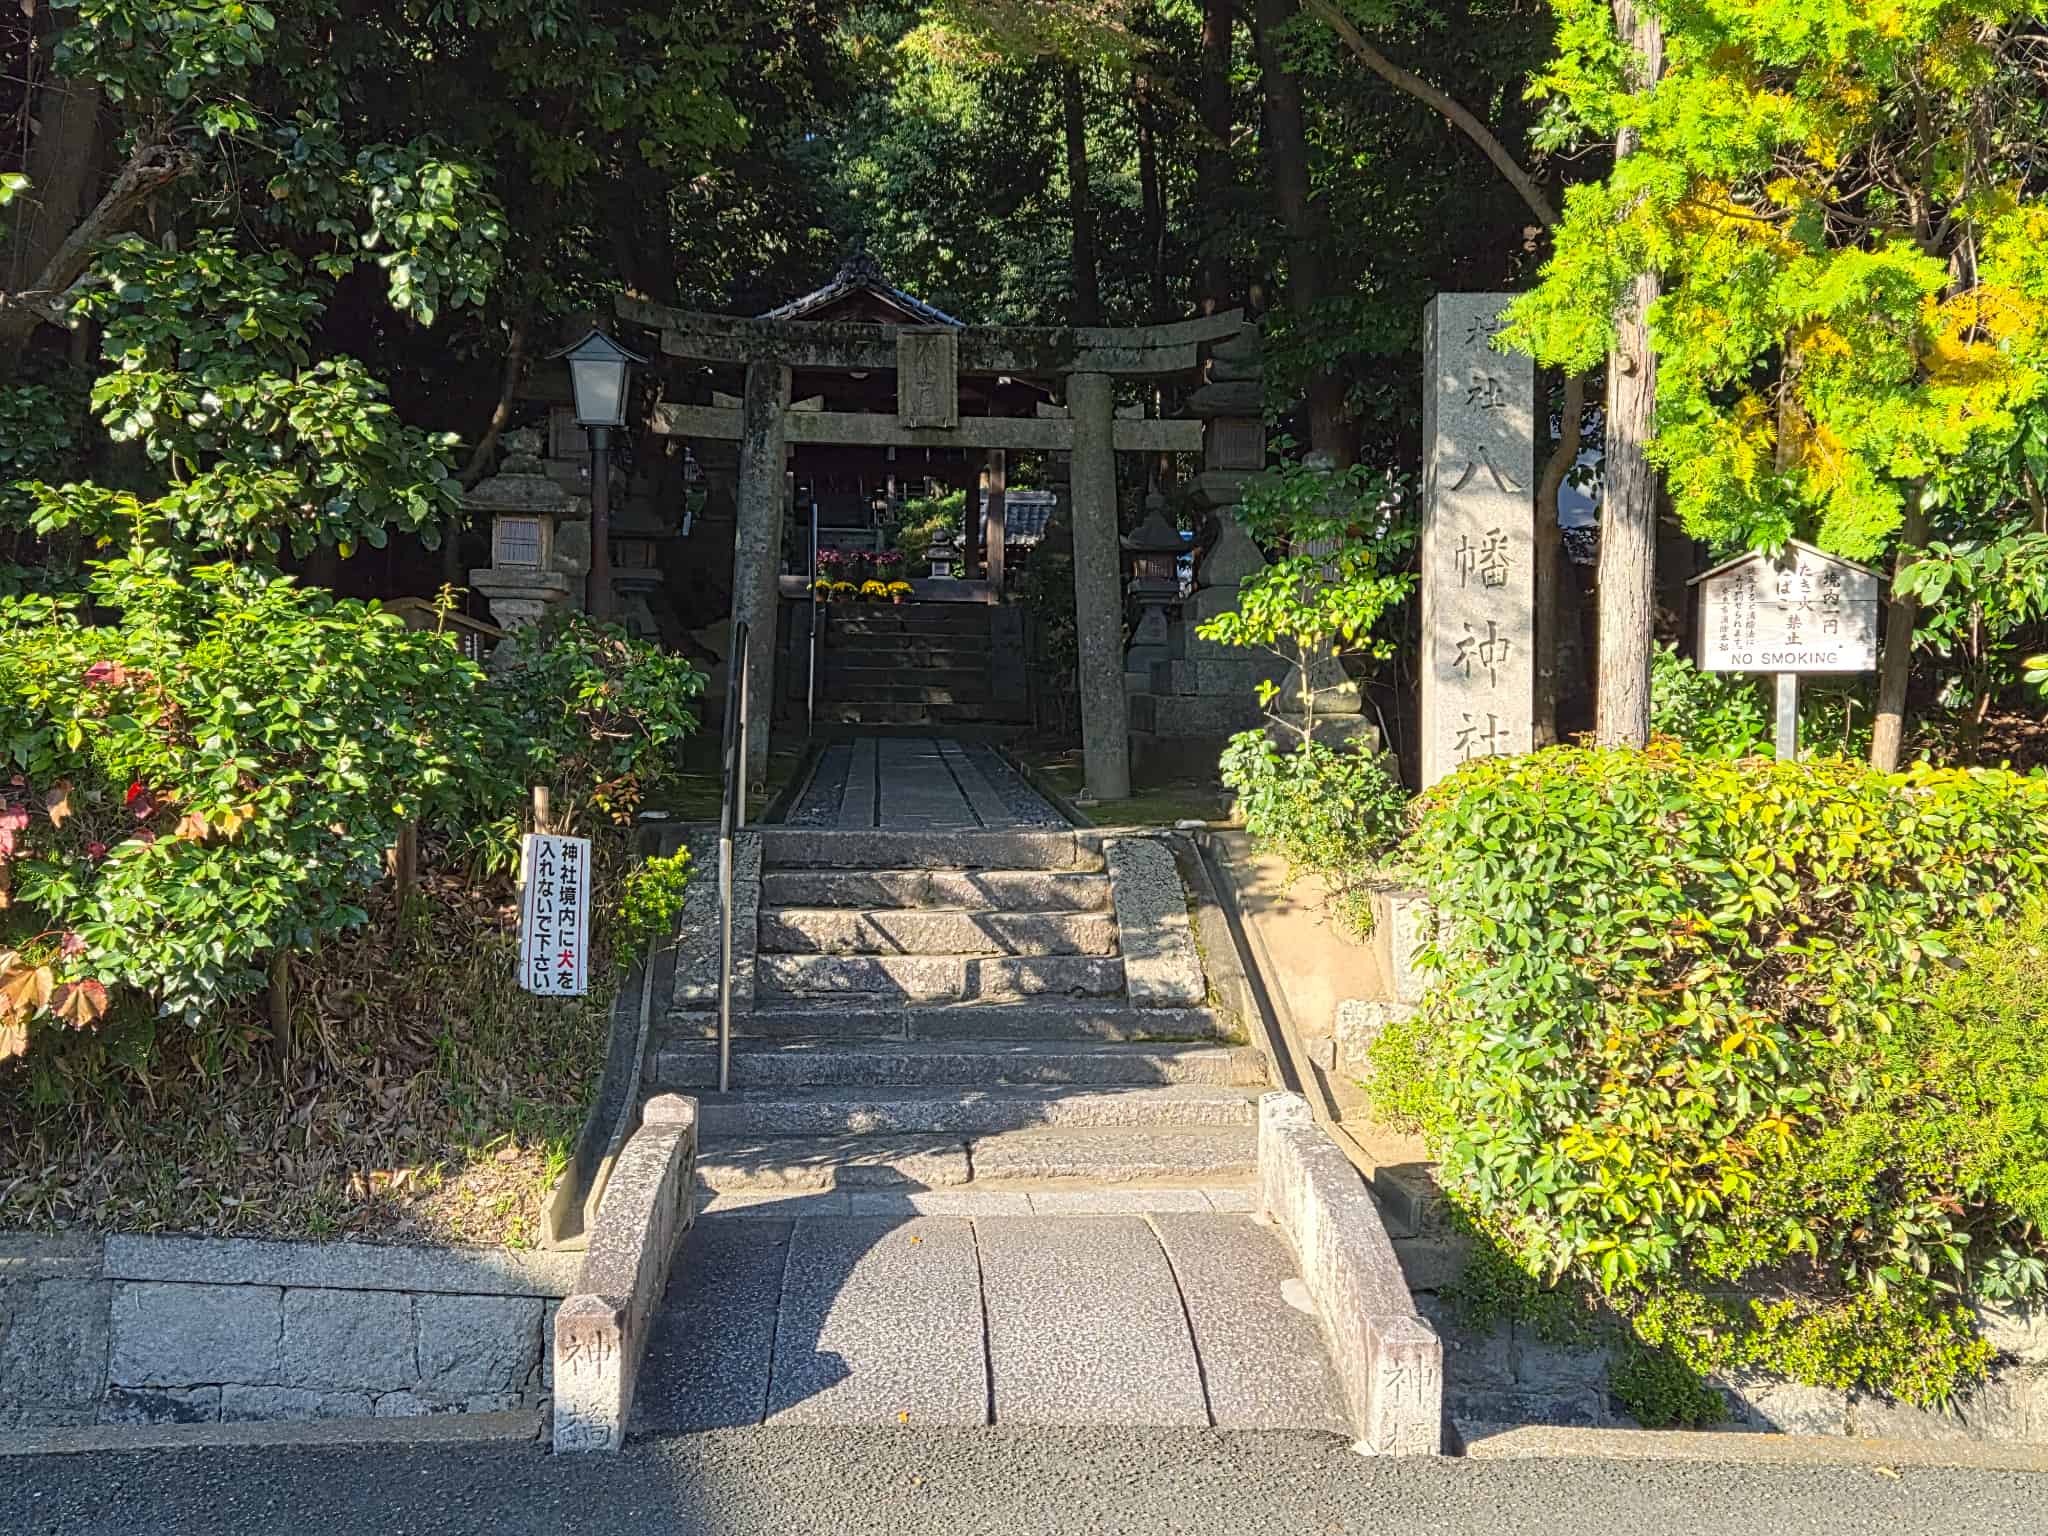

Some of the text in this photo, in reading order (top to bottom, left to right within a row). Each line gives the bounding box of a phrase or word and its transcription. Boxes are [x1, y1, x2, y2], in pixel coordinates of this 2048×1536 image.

[1776, 567, 1794, 611] ばこ
[1797, 562, 1815, 612] たき火
[1822, 570, 1841, 635] 境内一円
[1784, 613, 1803, 646] 禁止
[1731, 652, 1839, 665] NO SMOKING
[533, 840, 556, 989] 入れないで下さい
[556, 842, 578, 990] 神社境内に犬を
